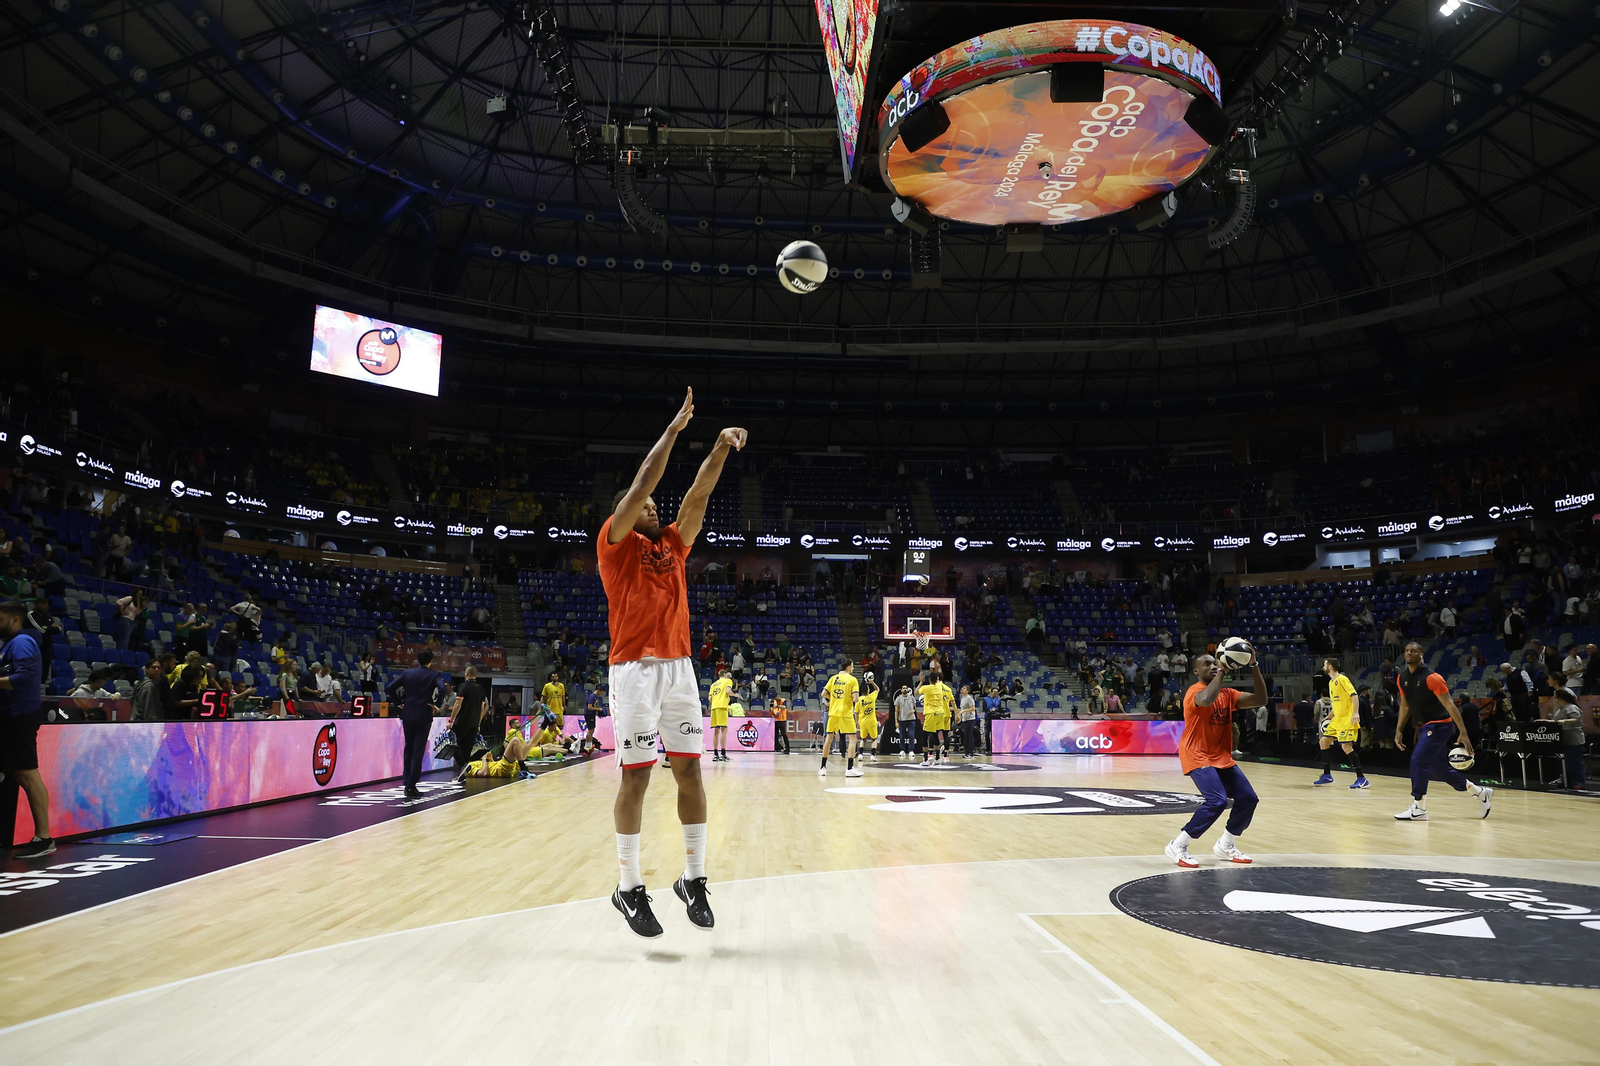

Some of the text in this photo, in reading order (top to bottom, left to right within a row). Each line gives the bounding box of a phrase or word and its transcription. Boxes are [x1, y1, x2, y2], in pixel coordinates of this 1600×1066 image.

[889, 89, 920, 127] acb
[1068, 85, 1136, 153] Copa
[1109, 101, 1146, 138] acb
[993, 132, 1045, 198] Málaga 2024
[1056, 154, 1087, 178] del
[1027, 180, 1077, 209] Rey
[686, 726, 702, 735] Mide
[738, 730, 758, 738] BAXI
[1075, 733, 1113, 749] acb
[1525, 732, 1560, 741] SPALDING
